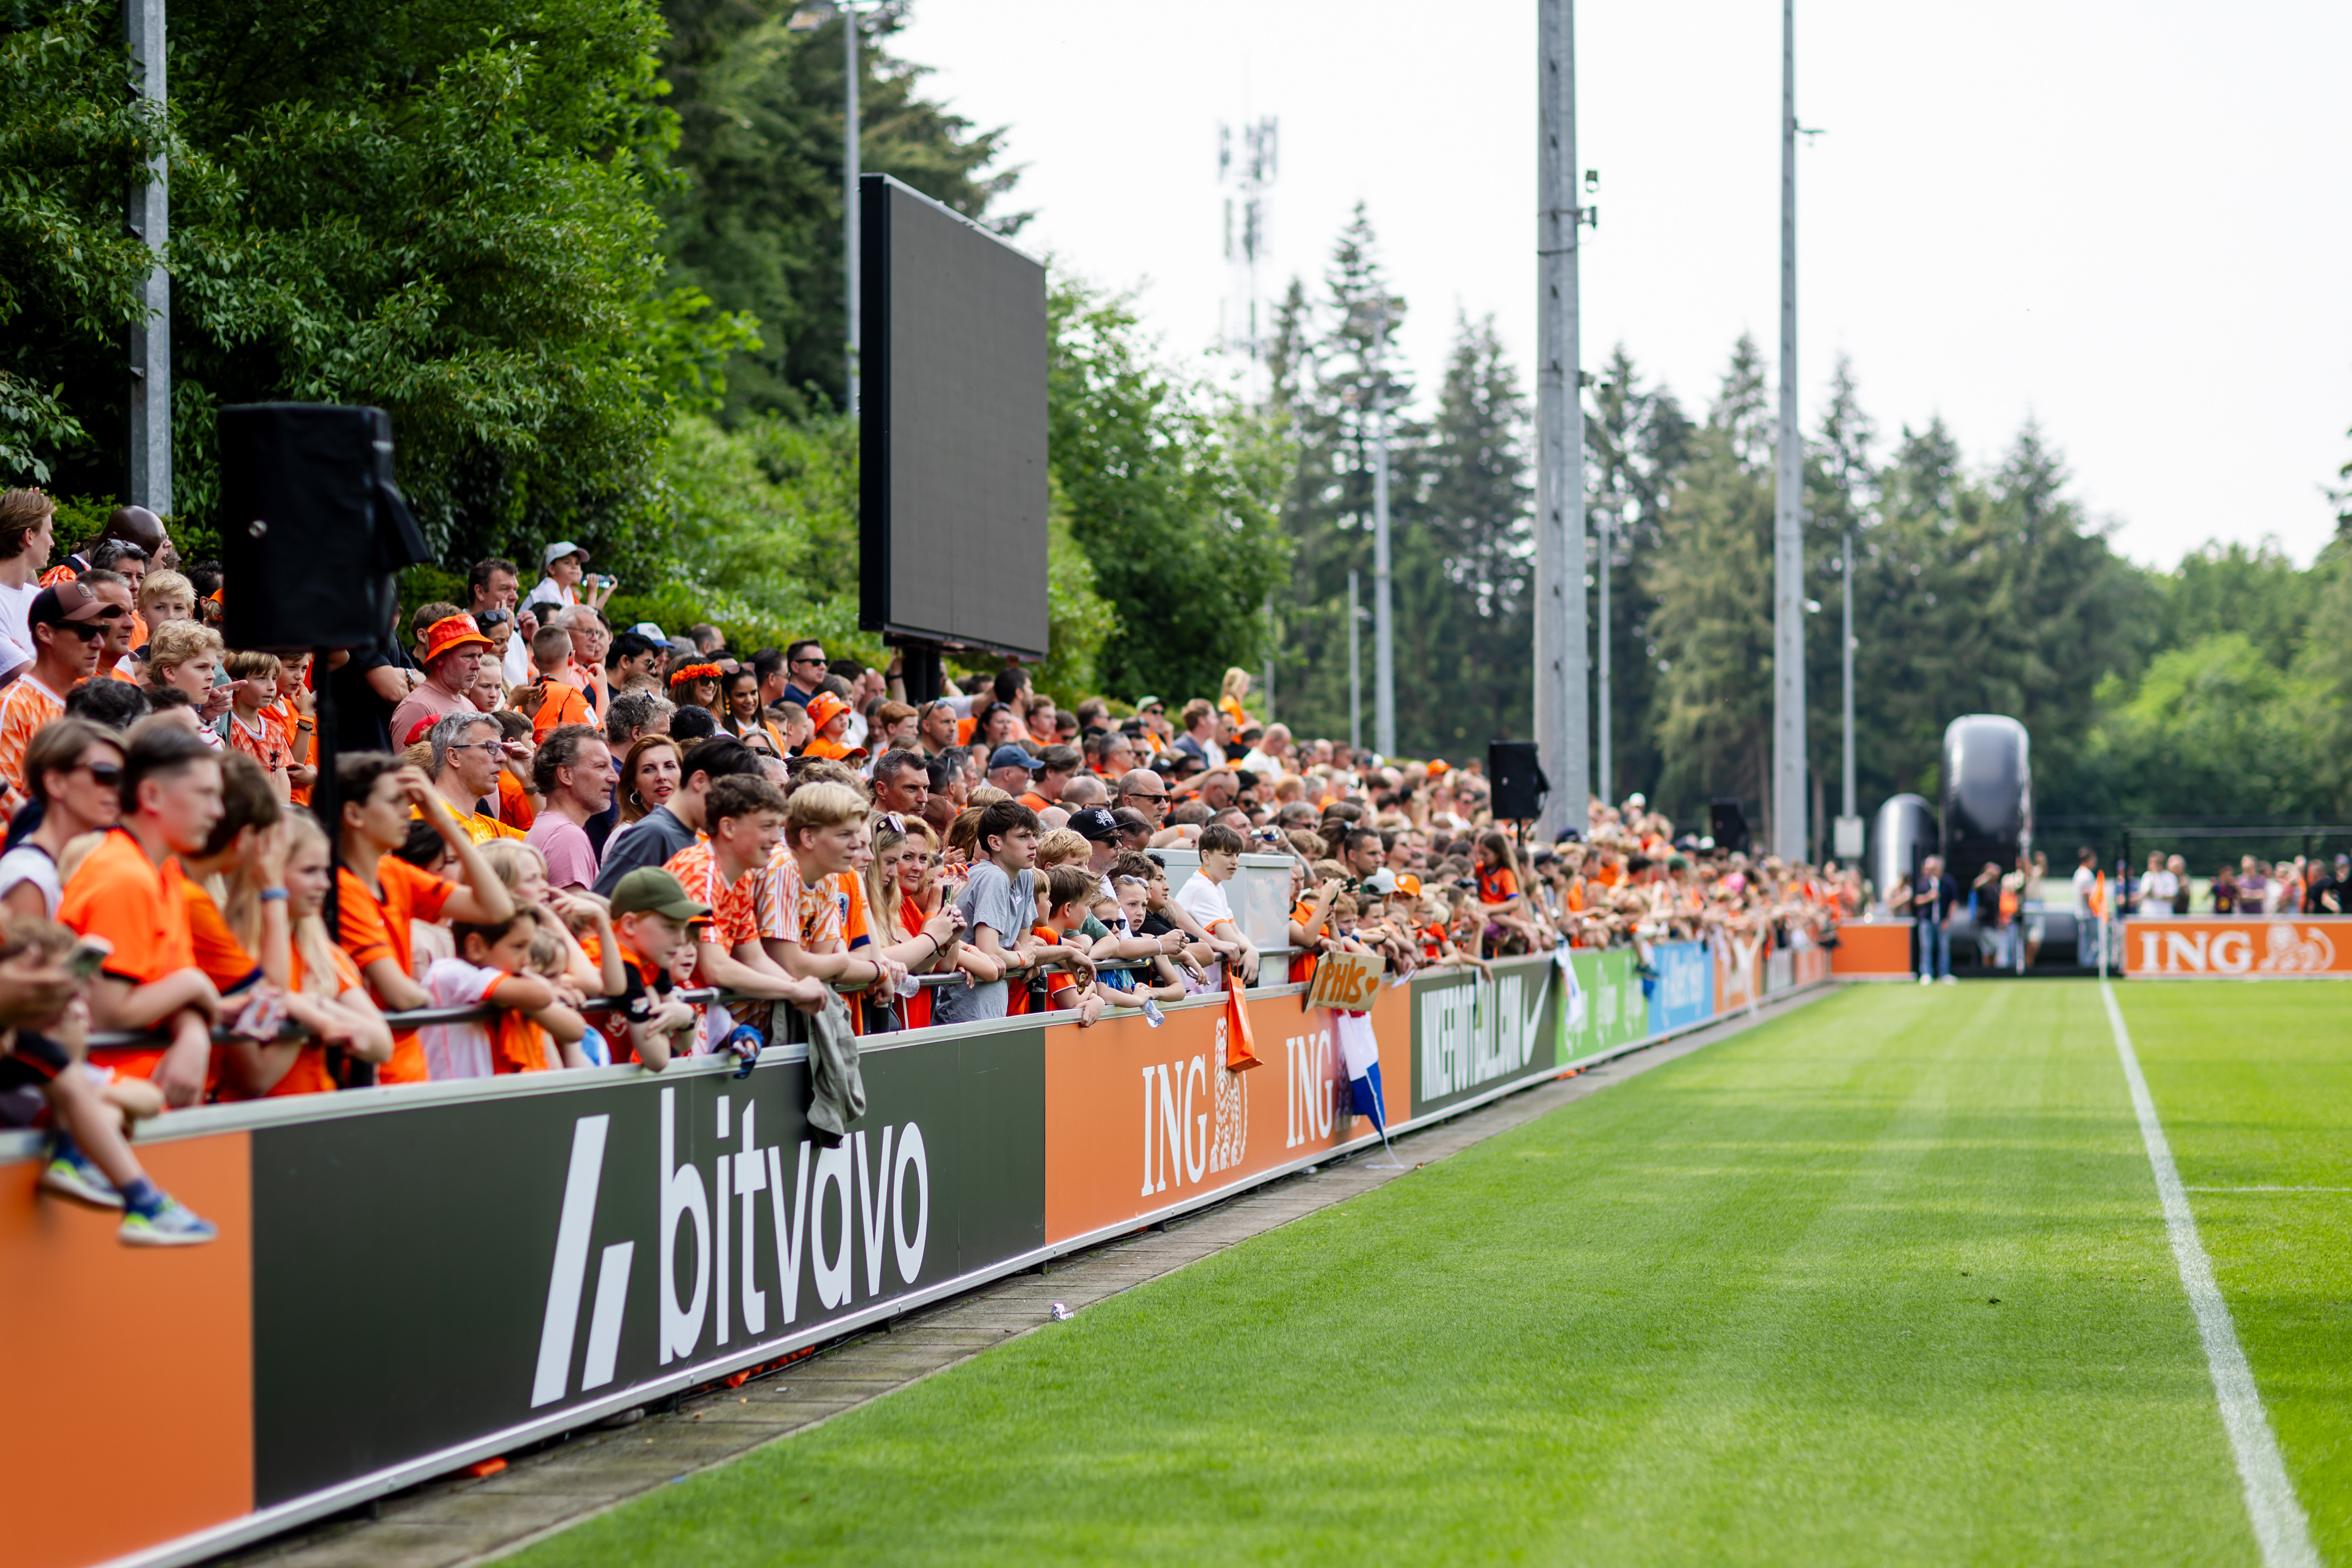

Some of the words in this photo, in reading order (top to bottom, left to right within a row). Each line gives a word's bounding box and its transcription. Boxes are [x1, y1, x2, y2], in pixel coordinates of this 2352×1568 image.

[2139, 930, 2255, 974] ING
[1141, 1053, 1207, 1197] ING
[1286, 1028, 1333, 1148] ING
[660, 1087, 928, 1365] bitvavo
